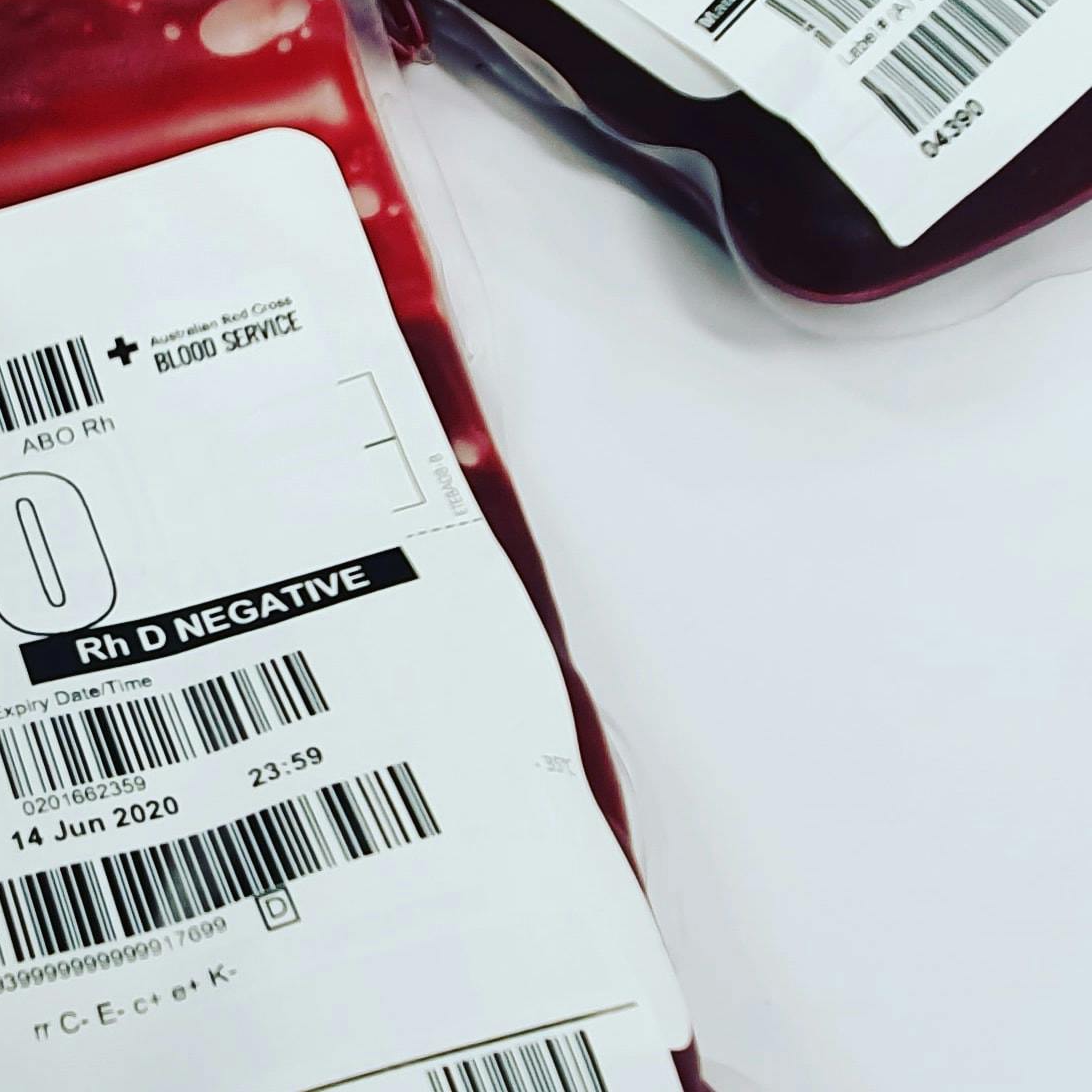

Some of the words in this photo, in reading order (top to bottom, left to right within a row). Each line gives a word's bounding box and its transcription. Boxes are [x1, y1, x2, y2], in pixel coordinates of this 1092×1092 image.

[921, 99, 984, 158] 04390
[150, 321, 218, 348] Australian
[221, 309, 249, 325] Red
[251, 297, 293, 314] Cross
[153, 337, 218, 374] BLOOD
[221, 310, 303, 352] SERVICE
[23, 427, 75, 455] ABO
[81, 416, 115, 437] Rh
[75, 635, 130, 664] Rh
[137, 624, 167, 652] D
[174, 565, 371, 640] NEGATIVE
[54, 677, 152, 706] Date/Time
[11, 826, 43, 851] 14
[54, 817, 106, 842] Jun
[112, 795, 179, 829] 2020
[248, 746, 323, 788] 23:59
[22, 775, 146, 816] 0201662359
[60, 1011, 89, 1034] C-
[97, 1001, 125, 1026] E-
[133, 993, 160, 1014] c+
[209, 966, 237, 987] K-
